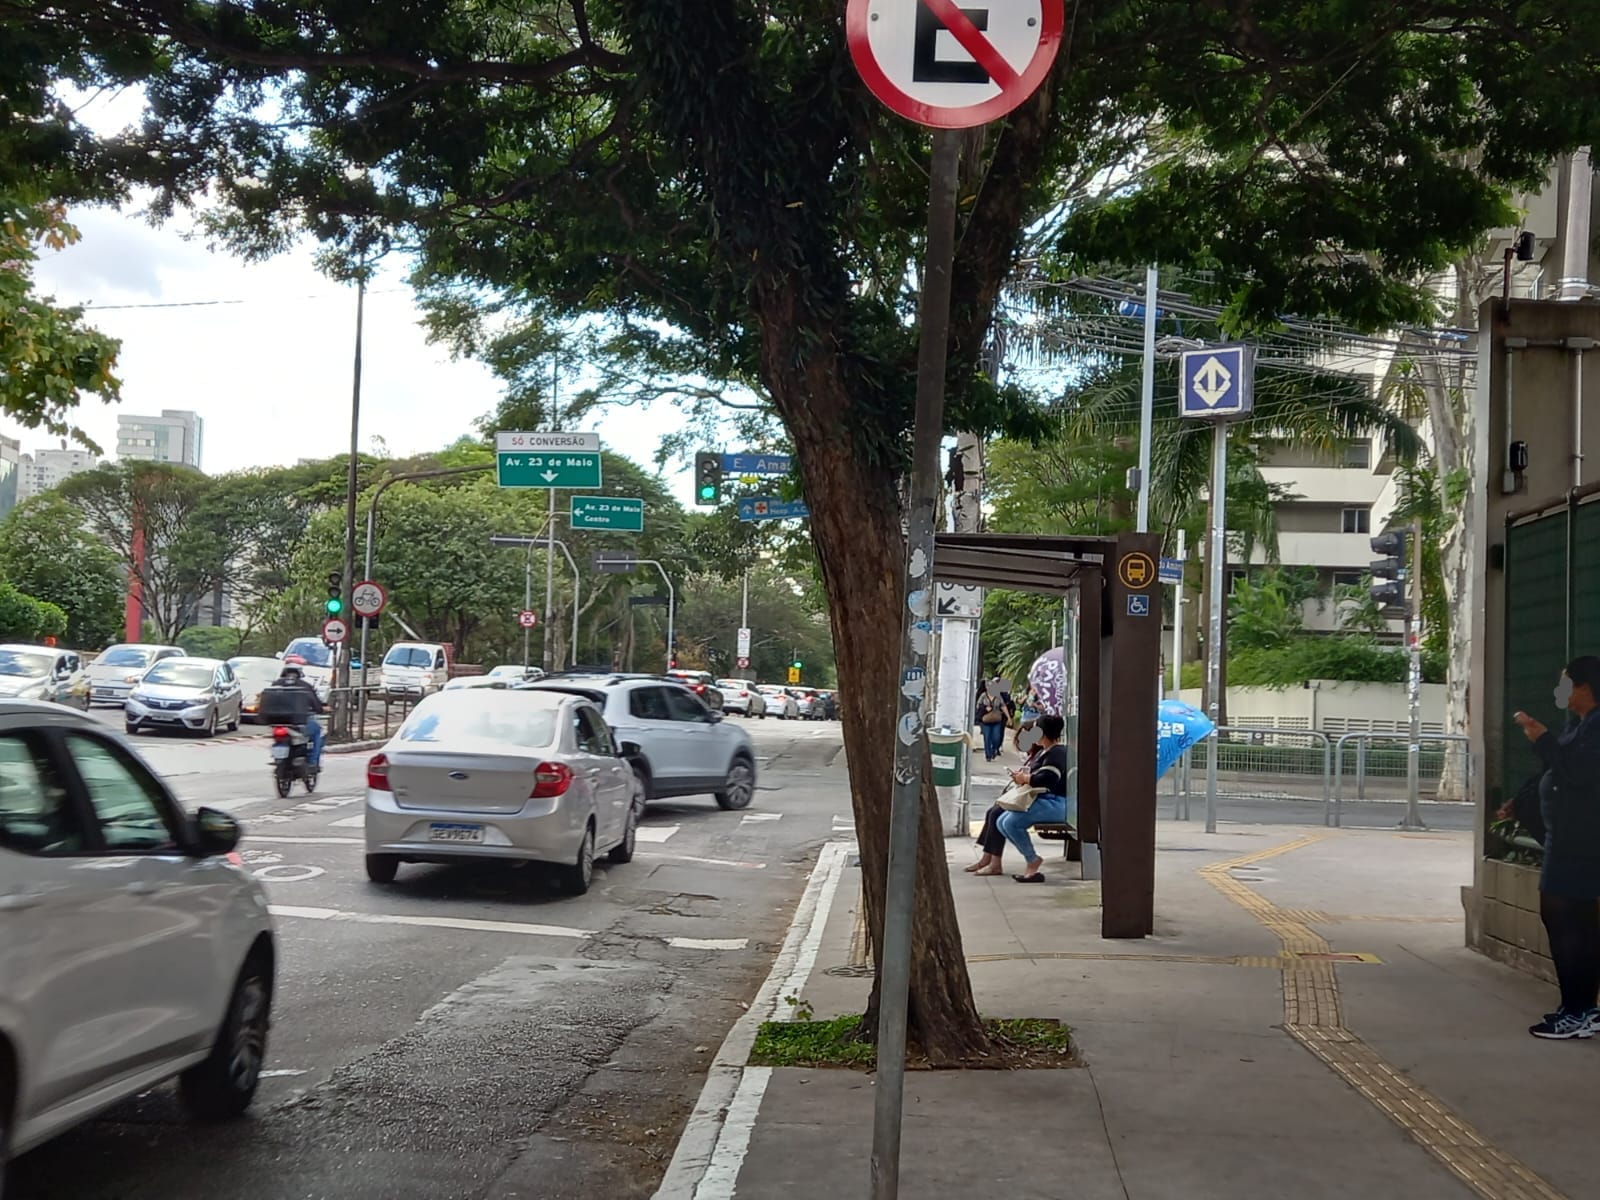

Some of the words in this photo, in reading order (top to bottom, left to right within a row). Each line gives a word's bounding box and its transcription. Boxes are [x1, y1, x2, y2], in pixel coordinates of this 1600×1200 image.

[511, 436, 524, 446] SÓ
[529, 436, 585, 446] CONVERSÃO
[505, 458, 524, 466] Av.
[528, 457, 543, 466] 23
[548, 458, 562, 467] de
[566, 458, 593, 467] Maio
